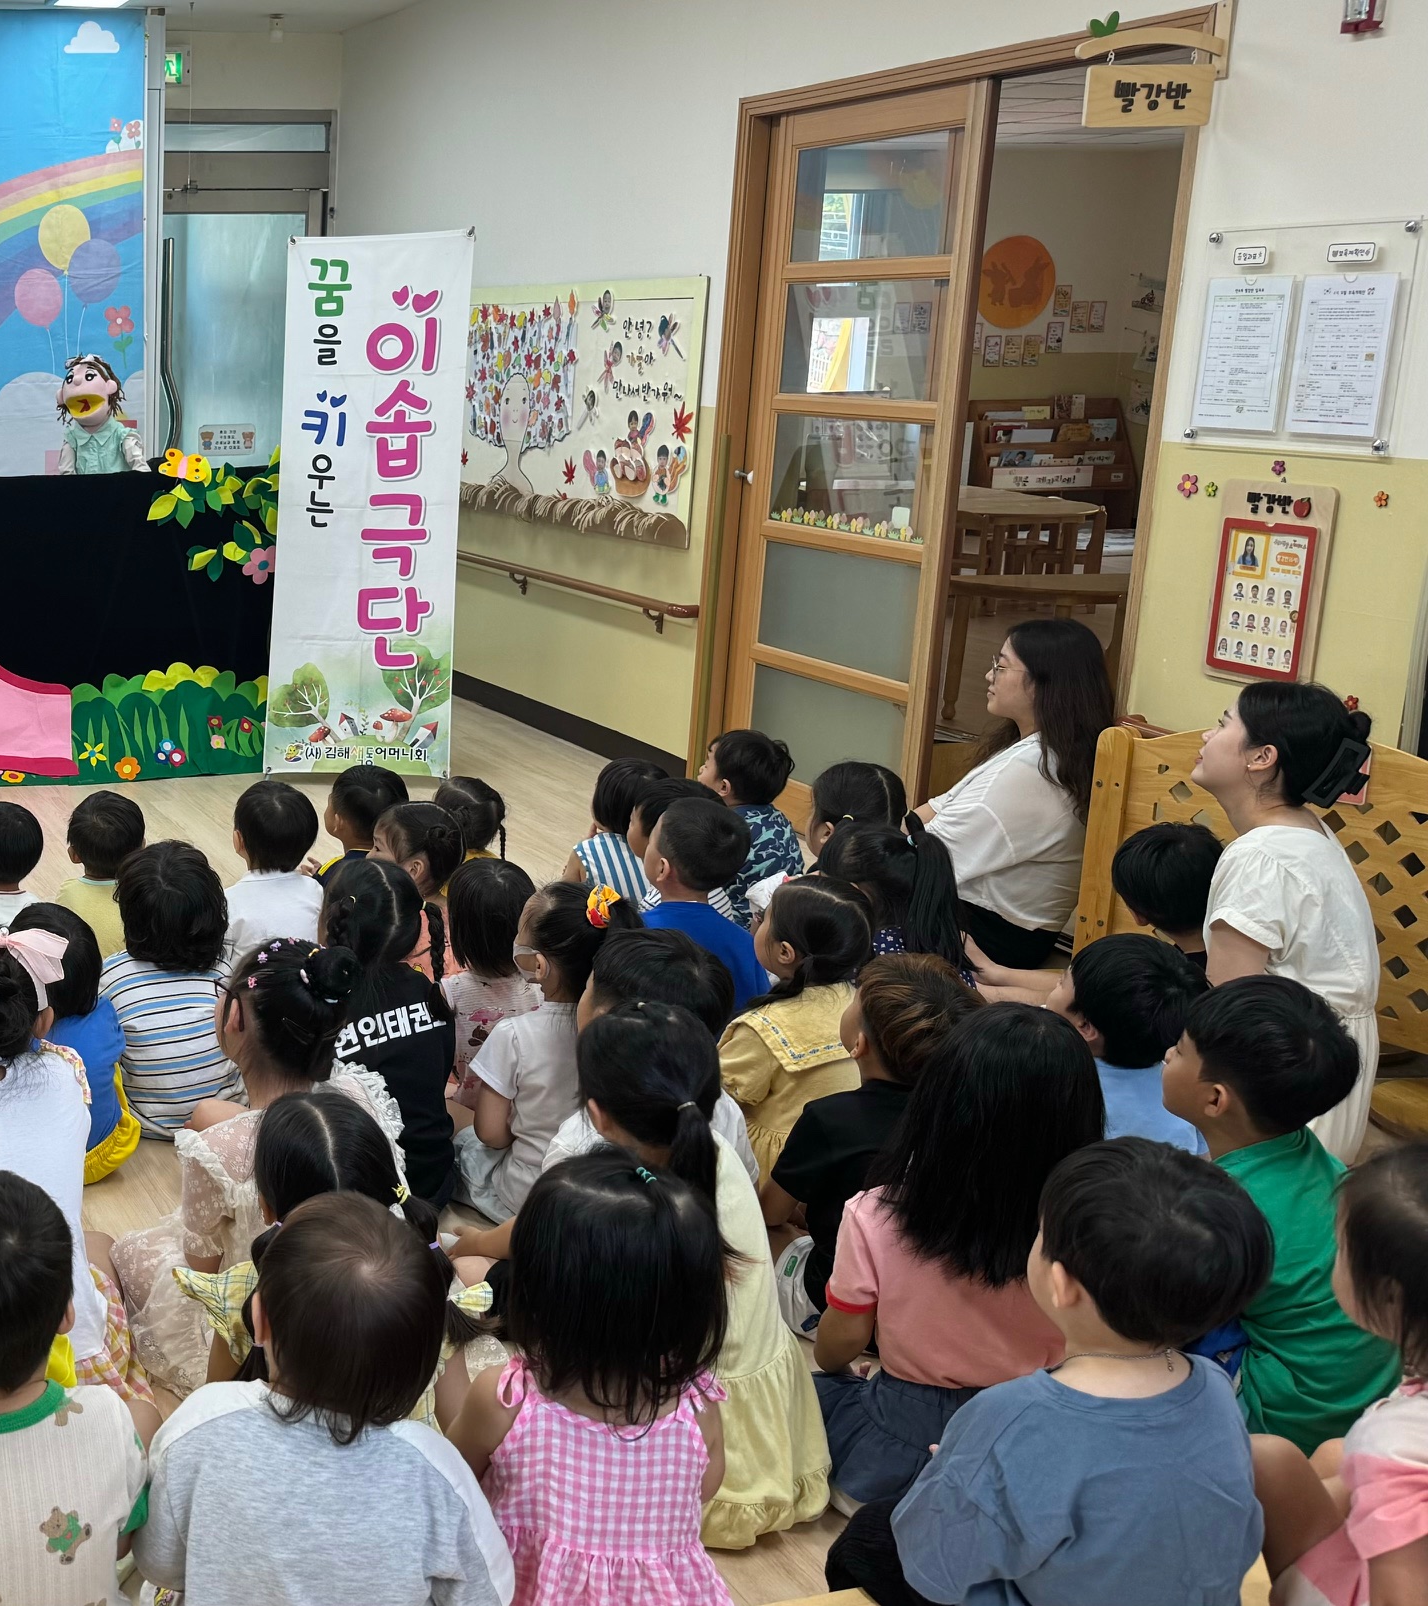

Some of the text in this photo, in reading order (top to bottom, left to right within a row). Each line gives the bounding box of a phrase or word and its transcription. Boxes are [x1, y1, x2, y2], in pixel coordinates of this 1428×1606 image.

[1114, 80, 1192, 113] 빨강반
[623, 317, 652, 339] 안녕?
[626, 346, 654, 375] 가을아
[301, 258, 353, 528] 꿈을 키우는
[613, 379, 640, 399] 만나서
[357, 316, 439, 668] 이솝극단
